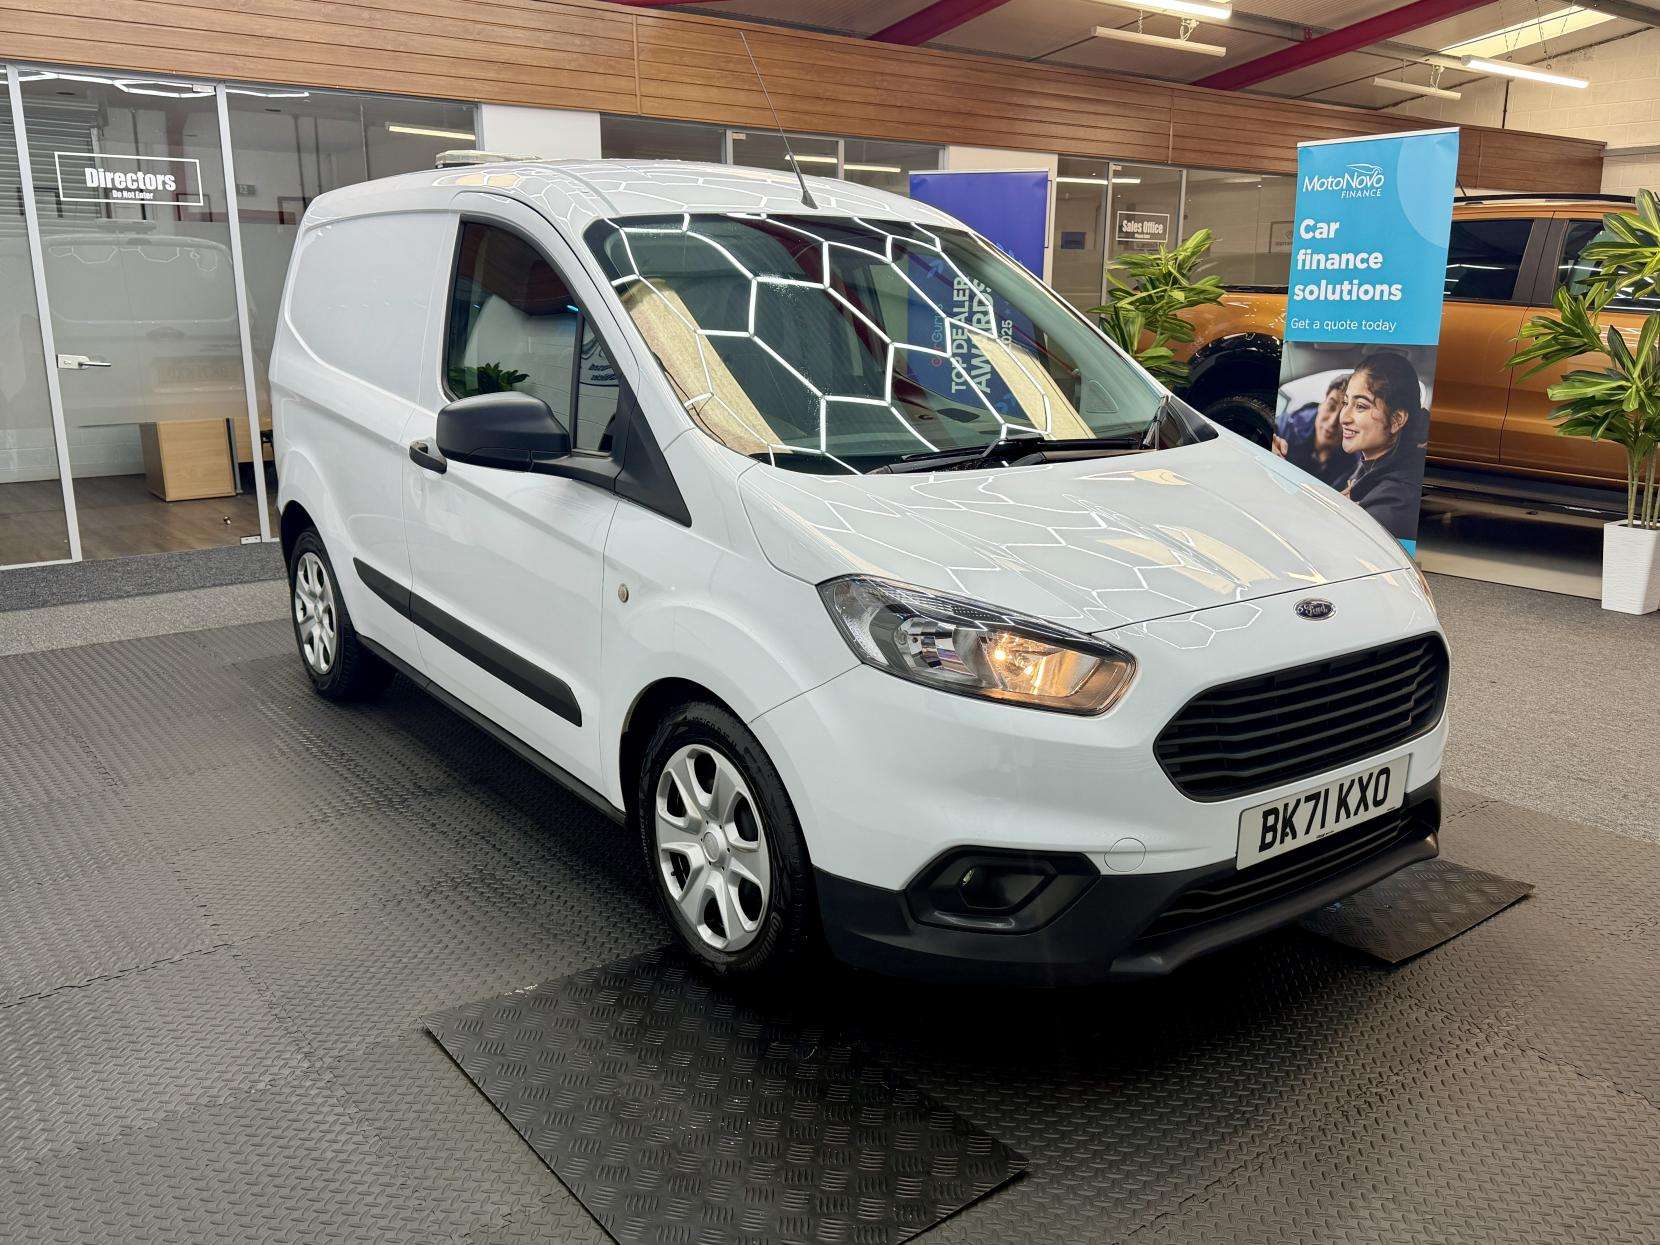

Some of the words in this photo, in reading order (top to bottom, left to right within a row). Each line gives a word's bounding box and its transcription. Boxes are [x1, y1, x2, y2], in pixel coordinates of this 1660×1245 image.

[84, 167, 176, 191] Directors
[1302, 171, 1385, 192] MotoNovo
[112, 189, 123, 198] Do
[123, 190, 135, 199] Not
[135, 191, 154, 200] Enter
[1341, 189, 1382, 199] FINANCE
[1122, 220, 1142, 233] Sales
[1143, 221, 1164, 234] Office
[1299, 218, 1340, 240] Car
[1297, 249, 1384, 270] finance
[1293, 279, 1403, 301] solutions
[953, 276, 969, 354] DEALER
[1290, 318, 1310, 330] Get
[1312, 320, 1320, 329] a
[1323, 320, 1358, 332] quote
[1362, 319, 1397, 333] today
[951, 356, 967, 394] TOP
[1258, 787, 1330, 853] BK71
[1334, 766, 1391, 824] KXO
